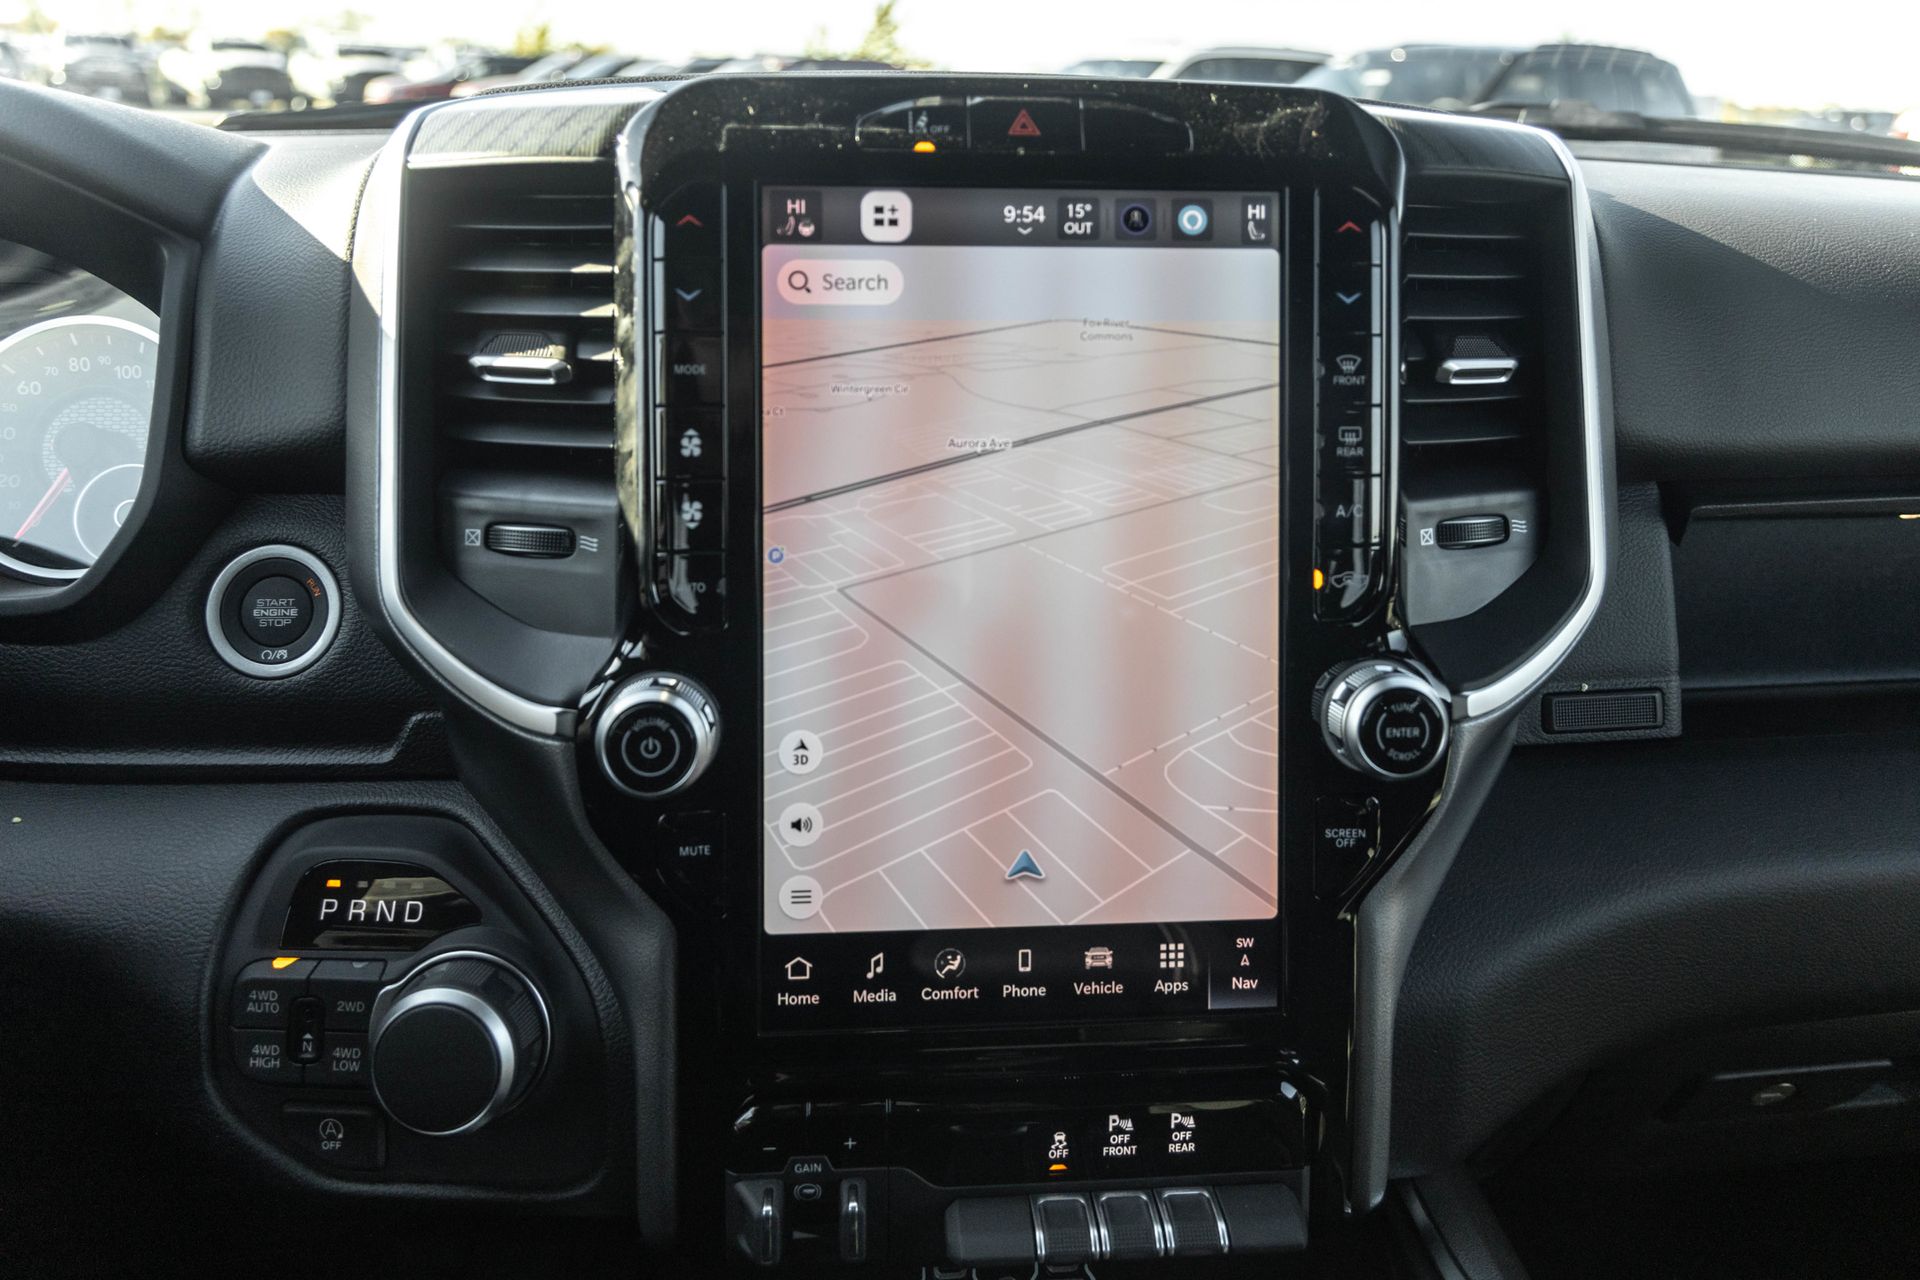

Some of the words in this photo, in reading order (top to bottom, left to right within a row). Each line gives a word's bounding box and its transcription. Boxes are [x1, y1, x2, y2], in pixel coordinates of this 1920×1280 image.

[786, 199, 807, 215] HI
[1066, 203, 1093, 219] 15°
[1247, 204, 1267, 220] HI
[1003, 205, 1046, 224] 9:54
[1063, 221, 1093, 235] OUT
[822, 273, 889, 292] Search
[1079, 330, 1134, 341] Commons
[68, 356, 91, 373] 80
[97, 355, 112, 367] 90
[45, 366, 59, 377] 70
[114, 364, 143, 380] 100
[673, 363, 707, 375] MODE
[1332, 375, 1367, 385] FRONT
[17, 380, 42, 396] 60
[947, 437, 987, 449] Aurora
[988, 437, 1011, 449] Ave
[1336, 446, 1364, 456] REAR
[1335, 503, 1364, 518] A/C
[305, 577, 321, 597] RUN
[256, 598, 296, 608] START
[253, 608, 299, 617] ENGINE
[259, 618, 292, 627] STOP
[1385, 727, 1420, 738] ENTER
[793, 754, 809, 766] 3D
[1324, 828, 1367, 839] SCREEN
[1335, 838, 1357, 849] OFF
[679, 845, 712, 857] MUTE
[1236, 937, 1255, 948] SW
[1073, 981, 1124, 996] Vehicle
[1154, 978, 1189, 994] Apps
[1231, 976, 1259, 990] Nav
[248, 989, 279, 1001] 4WD
[853, 989, 897, 1003] Media
[921, 985, 980, 1001] Comfort
[1002, 983, 1047, 998] Phone
[777, 992, 820, 1006] Home
[246, 1001, 280, 1014] AUTO
[336, 1000, 365, 1013] 2WD
[251, 1044, 280, 1056] 4WD
[332, 1047, 361, 1059] 4WD
[249, 1056, 281, 1069] HIGH
[332, 1059, 361, 1072] LOW
[1109, 1134, 1131, 1145] OFF
[1171, 1131, 1193, 1141] OFF
[321, 1140, 342, 1150] OFF
[1103, 1145, 1138, 1157] FRONT
[1168, 1142, 1196, 1153] REAR
[1048, 1149, 1070, 1159] OFF
[794, 1162, 823, 1174] GAIN
